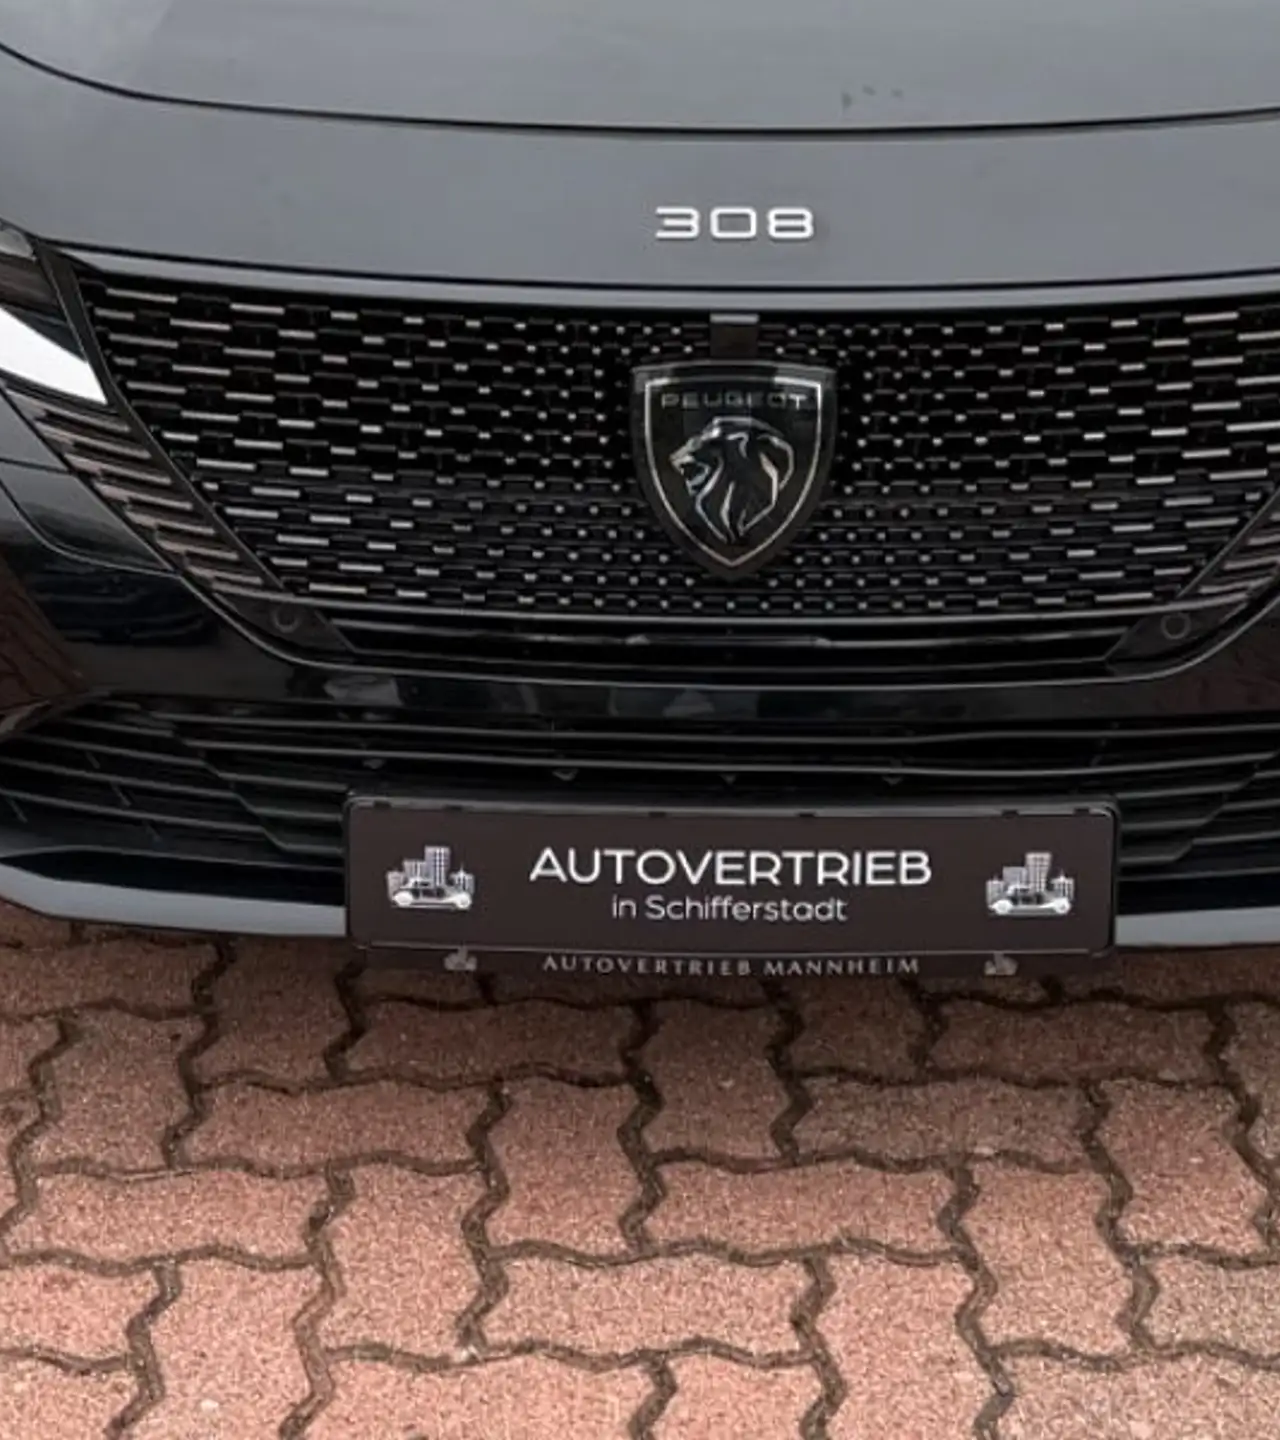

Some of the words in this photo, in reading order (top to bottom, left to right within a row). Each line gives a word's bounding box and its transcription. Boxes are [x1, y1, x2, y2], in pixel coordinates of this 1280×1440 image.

[655, 206, 814, 239] 308
[661, 392, 809, 410] PEUGEOT
[529, 847, 932, 885] AUTOVERTRIEB
[611, 895, 636, 919] in
[645, 894, 848, 923] Schifferstadt
[543, 955, 753, 976] AUTOVERTRIEB
[763, 956, 921, 976] MANNHEIM
